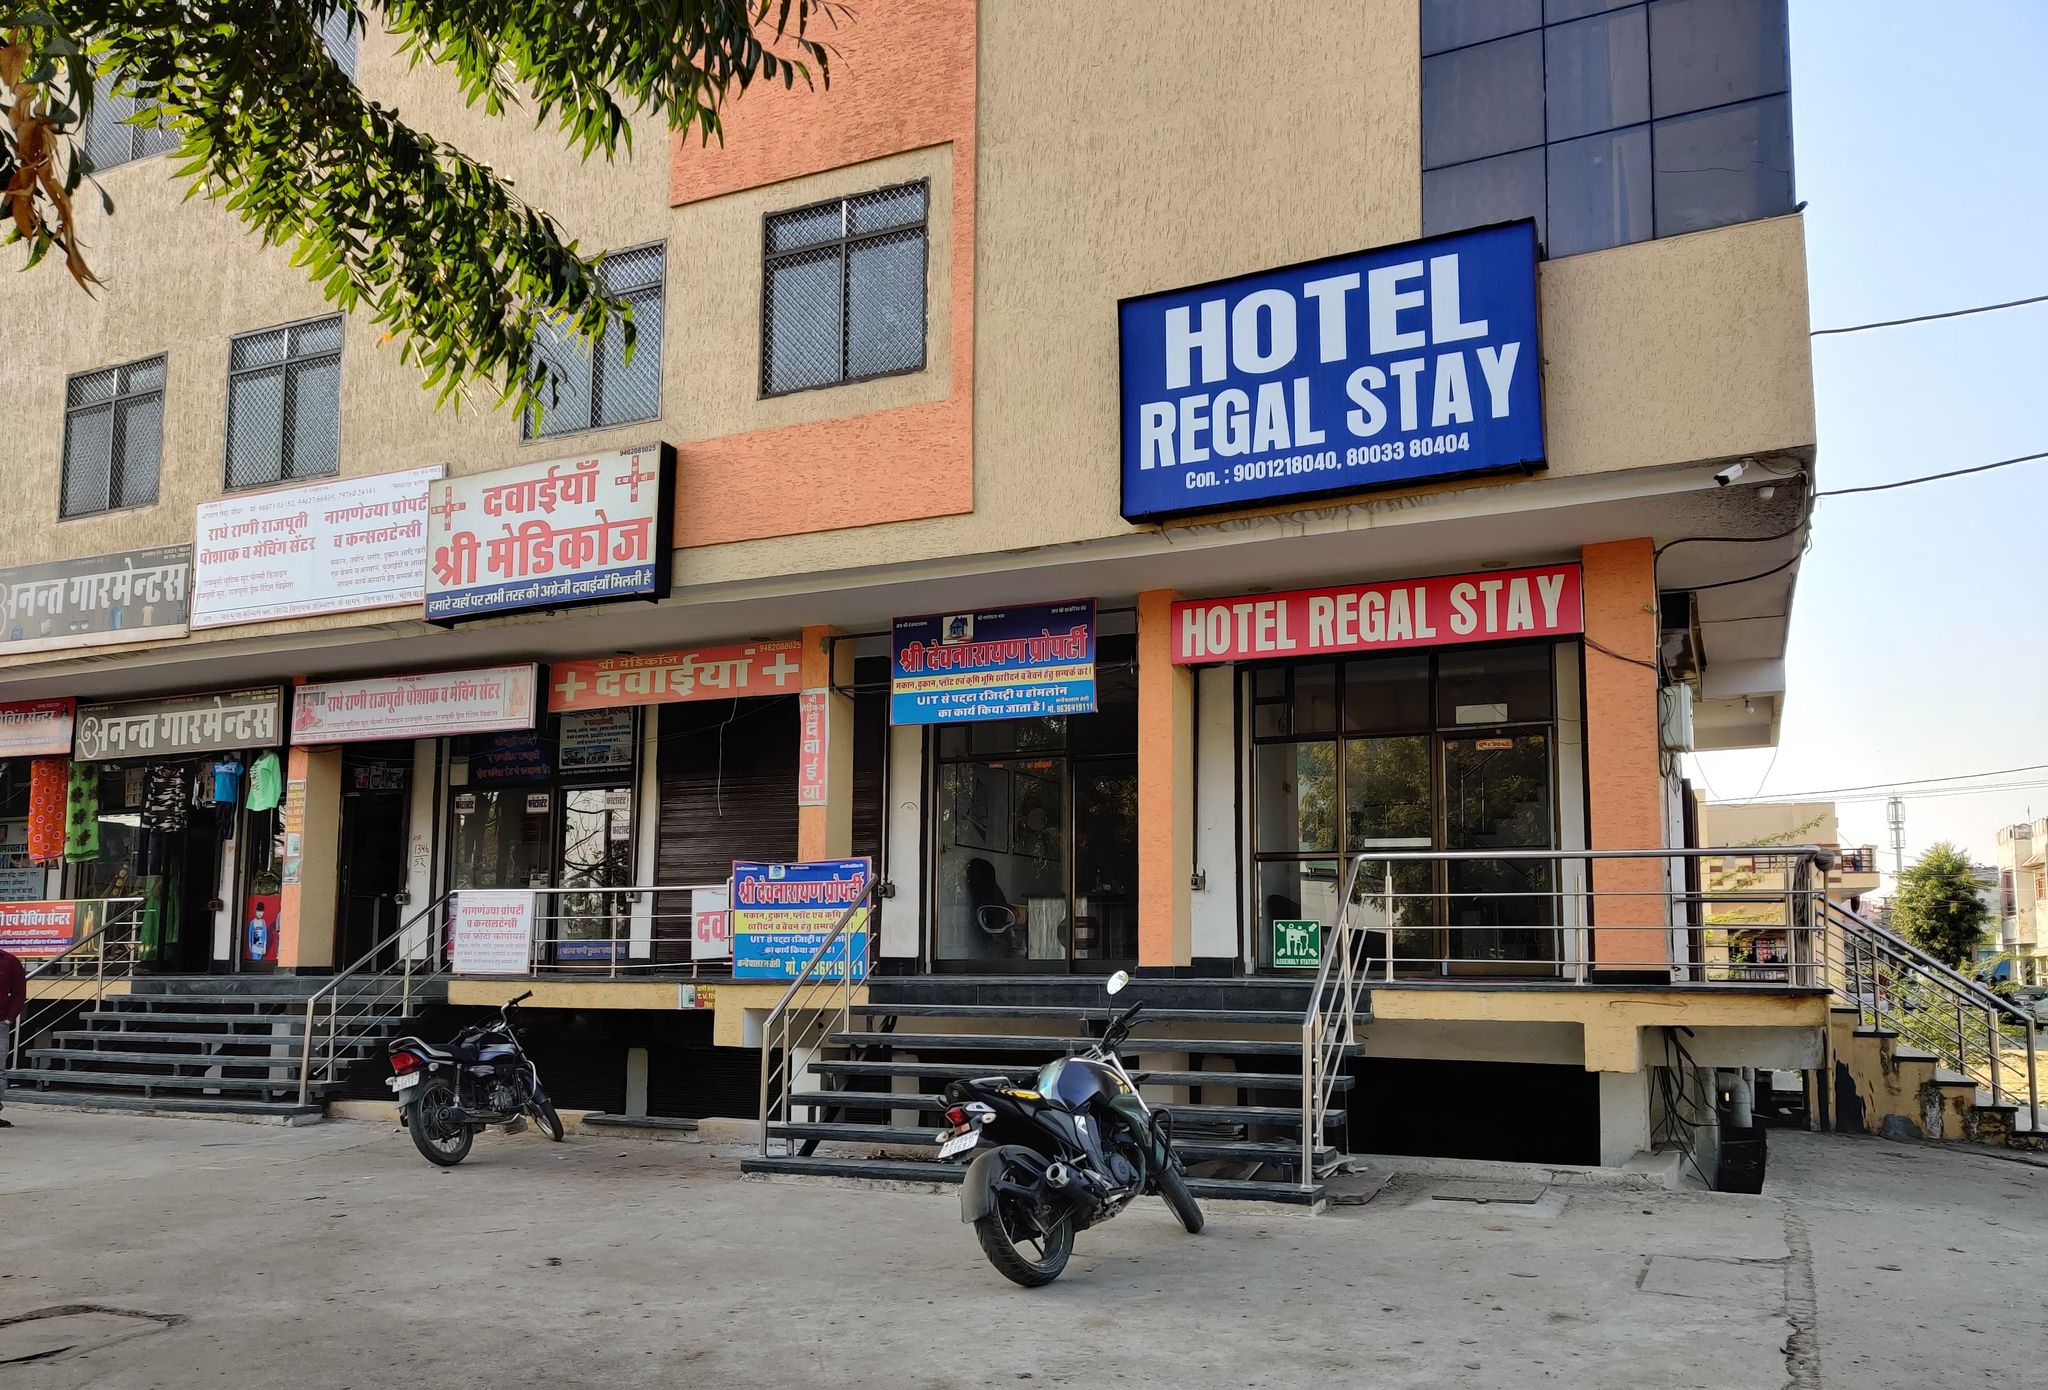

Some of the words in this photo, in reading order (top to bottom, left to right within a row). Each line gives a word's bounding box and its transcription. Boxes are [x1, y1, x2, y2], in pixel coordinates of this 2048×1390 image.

[1165, 253, 1489, 391] HOTEL
[1140, 376, 1325, 470] REGAL
[1346, 341, 1521, 437] STAY
[1186, 469, 1220, 490] Con.
[1233, 450, 1342, 484] 9001218040,
[1346, 441, 1405, 466] 80033
[1409, 432, 1470, 456] 80404
[483, 459, 600, 517] दवाईयाँ
[208, 523, 229, 541] राधे
[231, 519, 259, 537] राणी
[262, 511, 309, 535] राजपूती
[333, 535, 343, 548] व
[200, 548, 239, 565] पौशाक
[242, 546, 251, 559] व
[432, 531, 481, 585] श्री
[429, 599, 451, 611] हमारे
[471, 595, 483, 605] पर
[484, 588, 504, 604] सभी
[505, 589, 525, 601] तरह
[526, 584, 539, 599] की
[611, 571, 641, 589] मिलती
[643, 569, 652, 585] है
[1181, 599, 1297, 659] HOTEL
[1308, 586, 1437, 648] REGAL
[1449, 572, 1566, 636] STAY
[598, 658, 615, 670] श्री
[899, 641, 926, 673] श्री
[926, 637, 1028, 671] देवनारायण
[594, 649, 756, 696] दवाईयां
[327, 690, 344, 712] राधे
[346, 689, 367, 711] राणी
[368, 686, 404, 714] राजपूती
[406, 684, 439, 705] पौशाक
[441, 687, 449, 703] व
[916, 696, 938, 705] UIT
[941, 693, 950, 704] से
[1016, 688, 1024, 697] व
[1025, 685, 1068, 697] होमलोन
[938, 706, 952, 718] का
[954, 704, 976, 717] कार्य
[977, 703, 1004, 716] किया
[1006, 703, 1031, 714] जाता
[1032, 699, 1041, 713] है
[739, 876, 756, 905] श्री
[757, 875, 823, 904] देवनारायण
[750, 935, 766, 943] UIT
